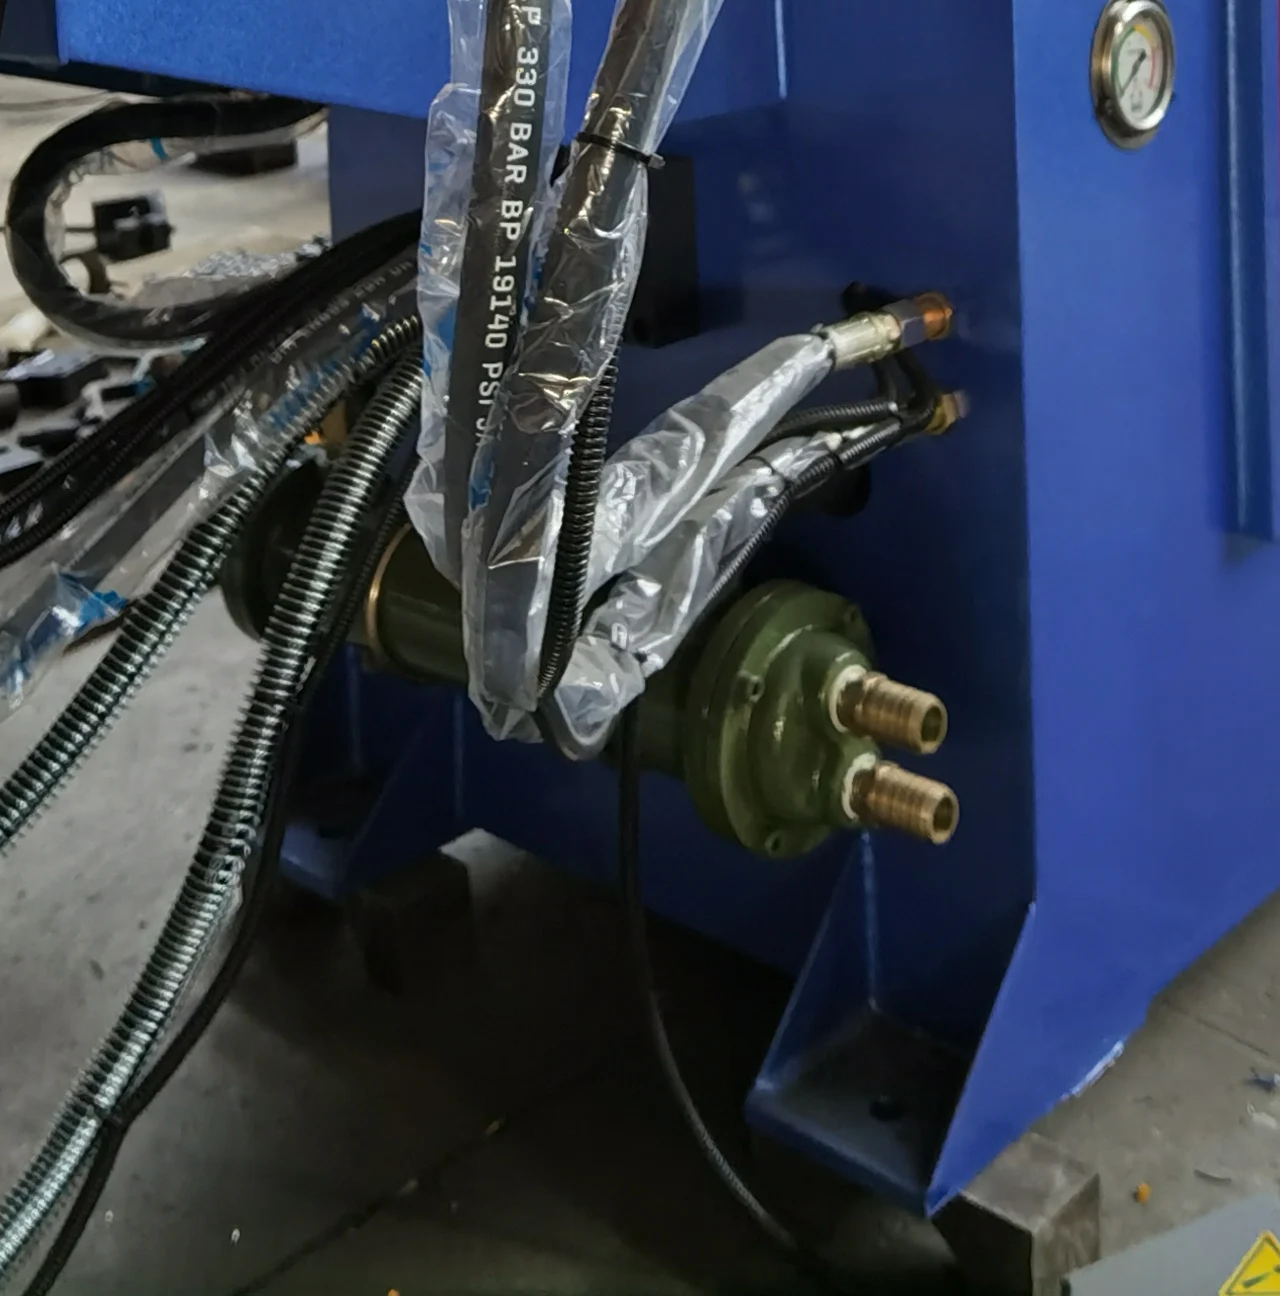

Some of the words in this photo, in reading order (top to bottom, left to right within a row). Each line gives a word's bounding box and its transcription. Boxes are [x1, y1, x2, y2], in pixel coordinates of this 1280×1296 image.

[513, 46, 539, 108] 330
[504, 122, 532, 184] BAR
[500, 199, 523, 241] BP
[484, 255, 517, 349] 19140
